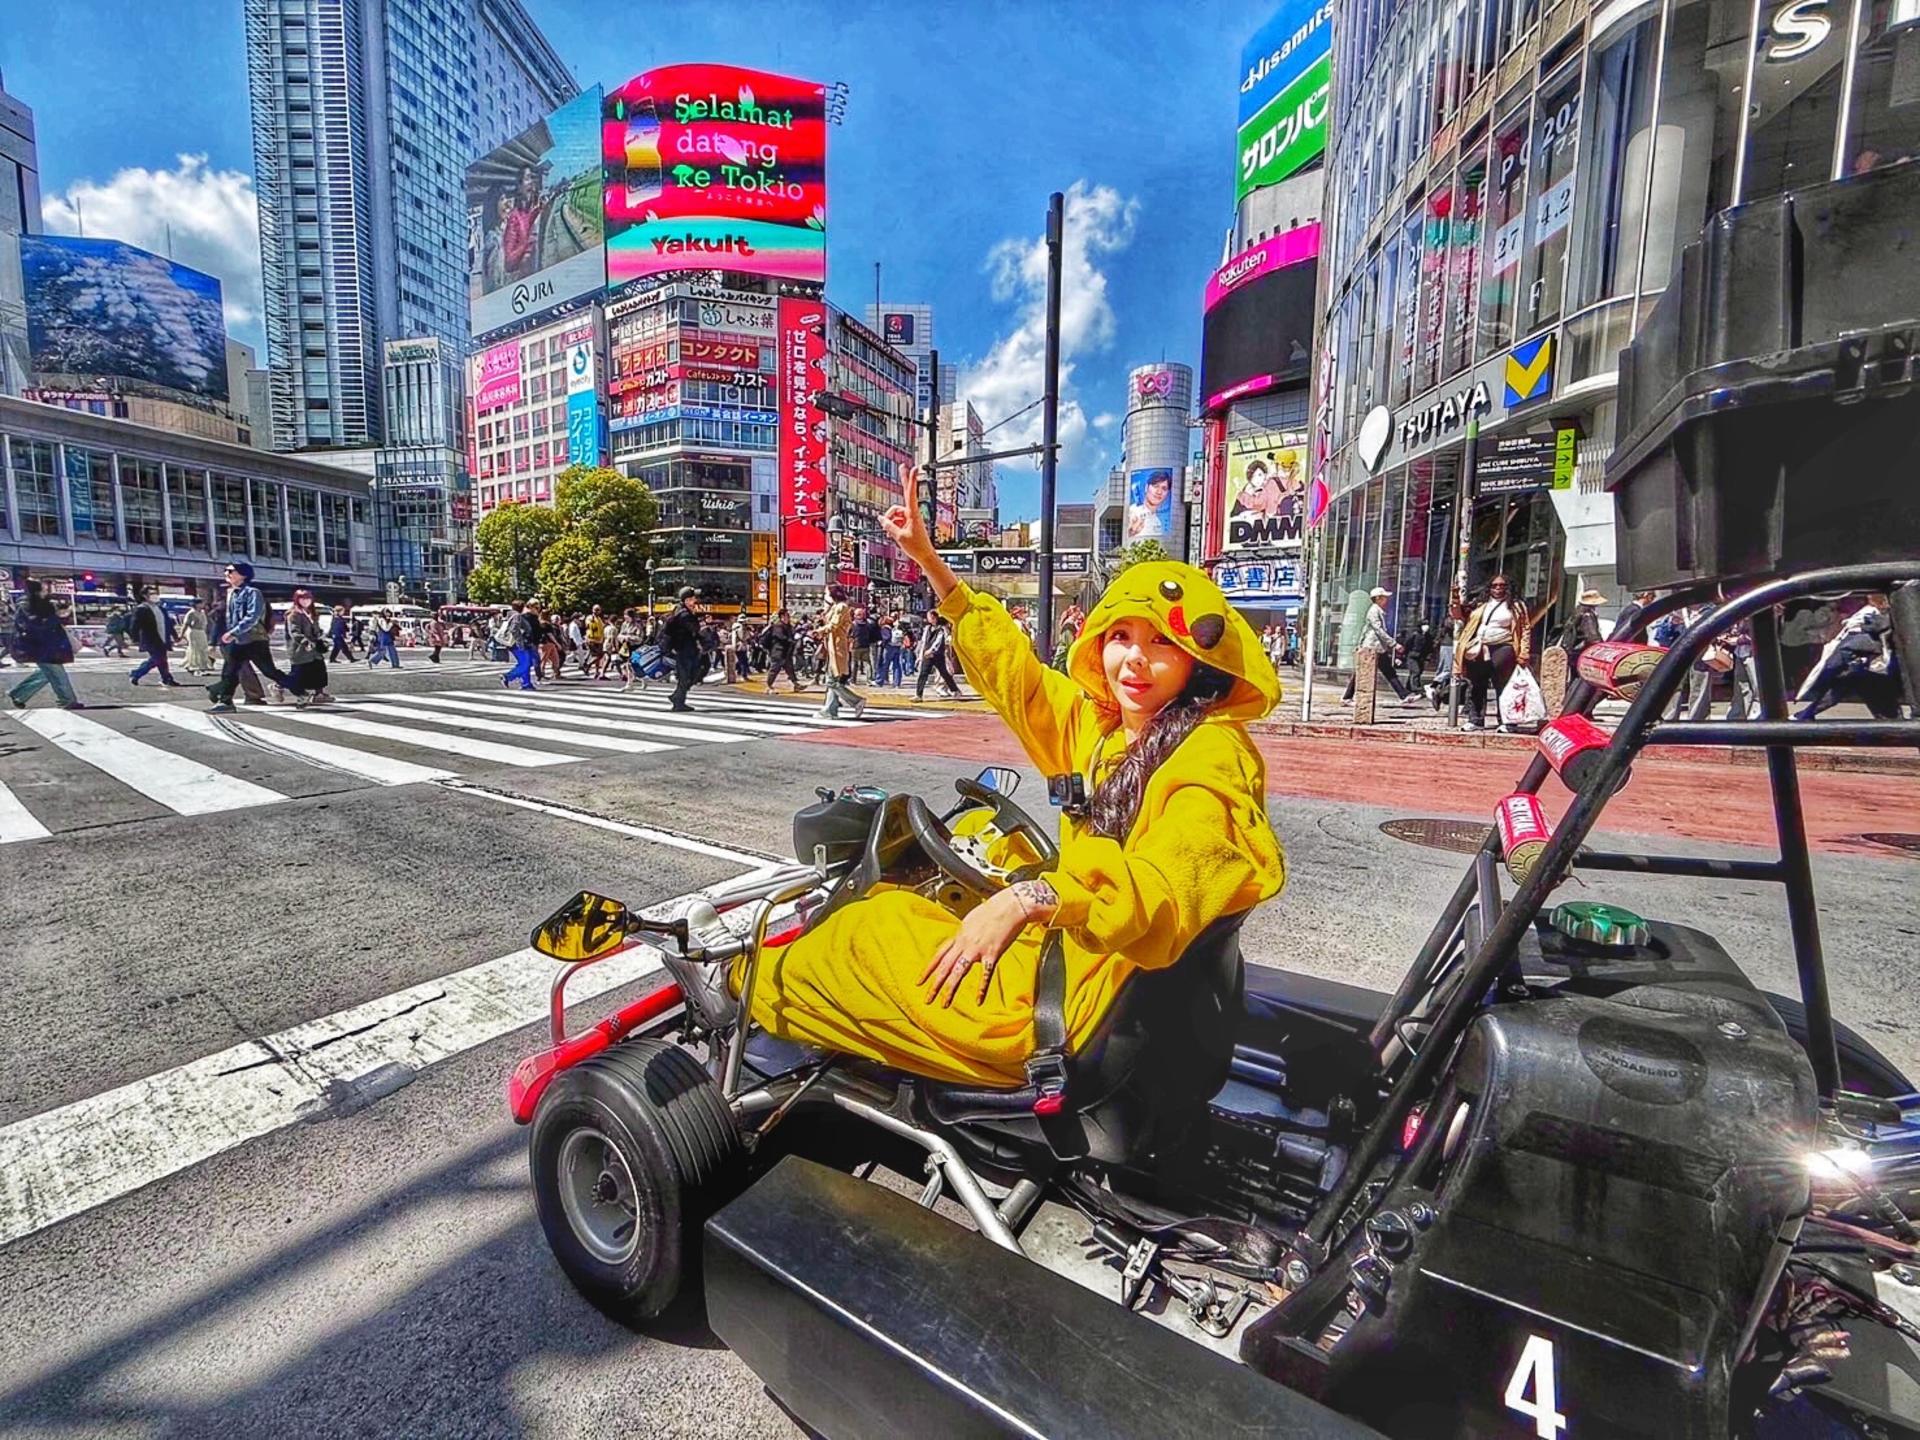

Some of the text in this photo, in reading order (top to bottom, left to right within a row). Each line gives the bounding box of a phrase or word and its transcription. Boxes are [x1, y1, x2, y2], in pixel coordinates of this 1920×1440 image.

[675, 93, 793, 130] Selamat
[677, 129, 779, 168] datng
[721, 165, 803, 200] Tokio
[651, 233, 755, 257] Yakult
[1218, 250, 1267, 286] Rakuten
[531, 280, 554, 303] JRA
[727, 308, 774, 329] しゃぶ葉
[682, 342, 756, 363] コンタクト
[646, 370, 668, 388] ガスト
[733, 373, 768, 388] ガスト
[1398, 383, 1487, 443] TSUTAYA
[1505, 1335, 1566, 1440] 4
